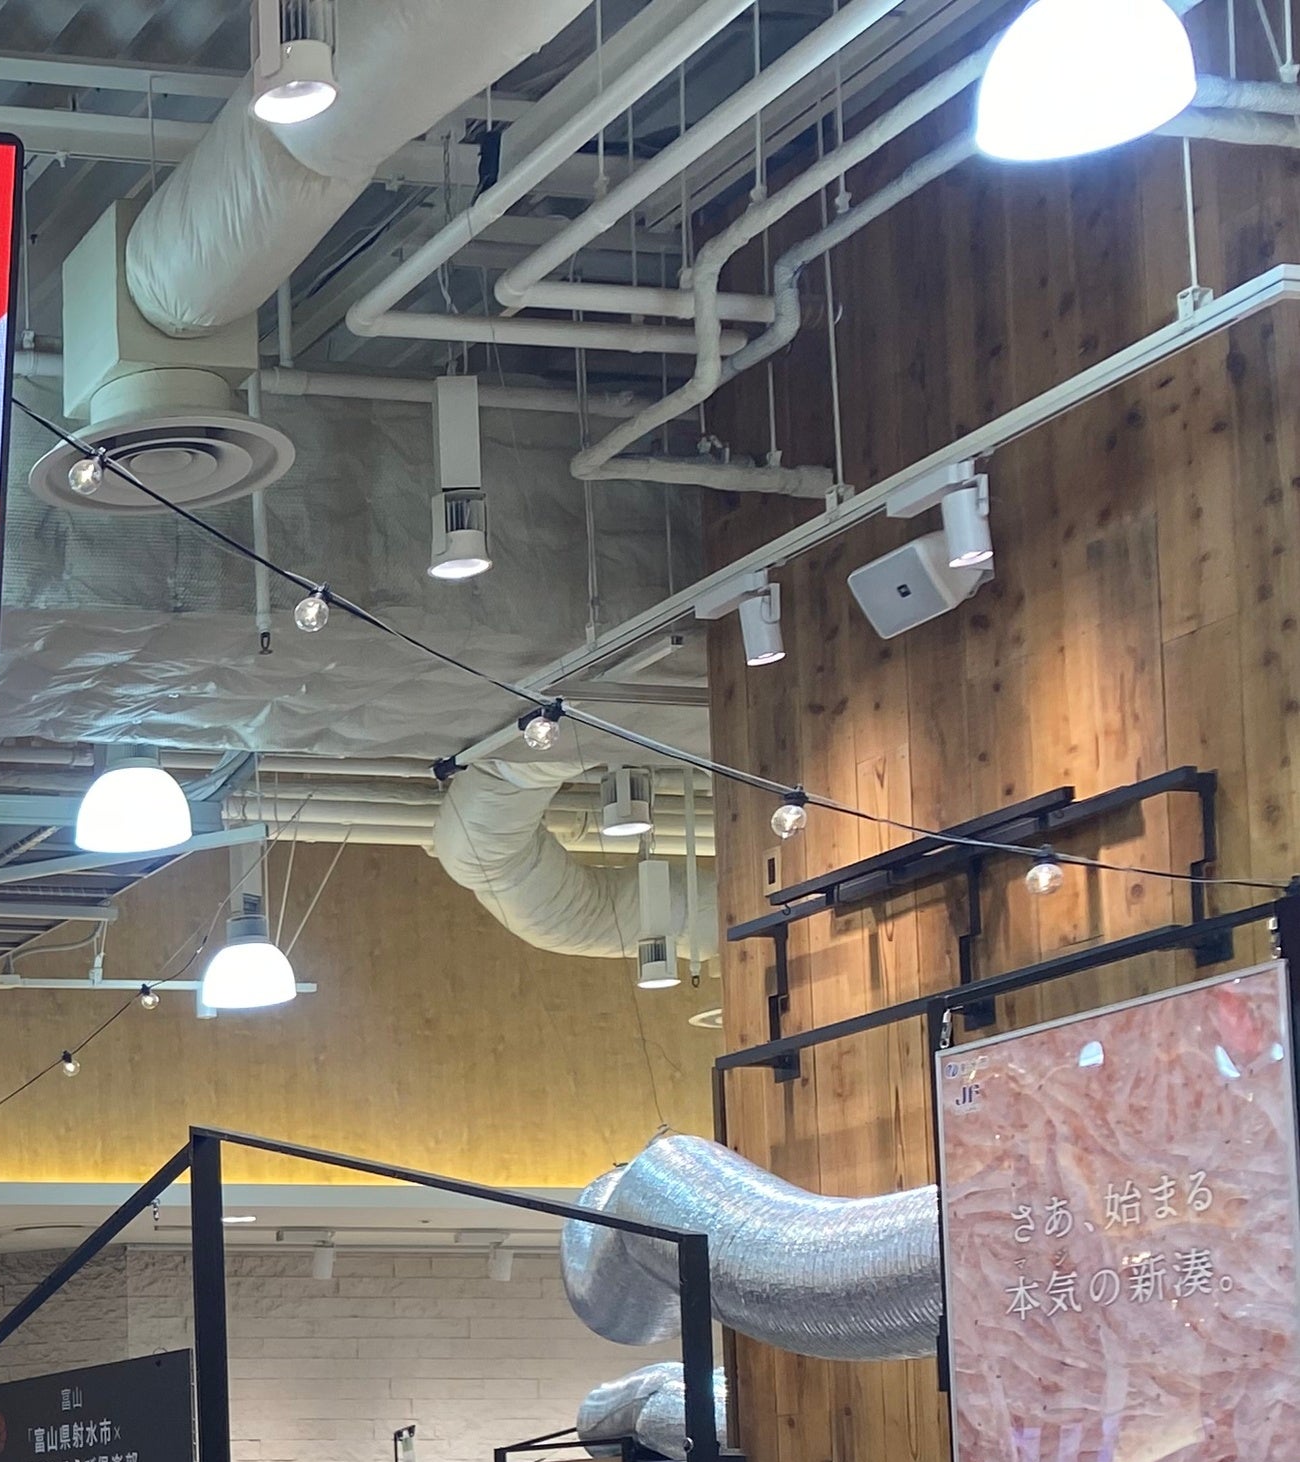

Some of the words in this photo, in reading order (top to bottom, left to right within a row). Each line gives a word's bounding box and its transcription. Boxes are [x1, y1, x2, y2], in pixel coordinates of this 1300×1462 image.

[1011, 1170, 1212, 1243] さあ、始まる
[1005, 1247, 1233, 1321] 本気の新湊。
[61, 1386, 83, 1411] 富山
